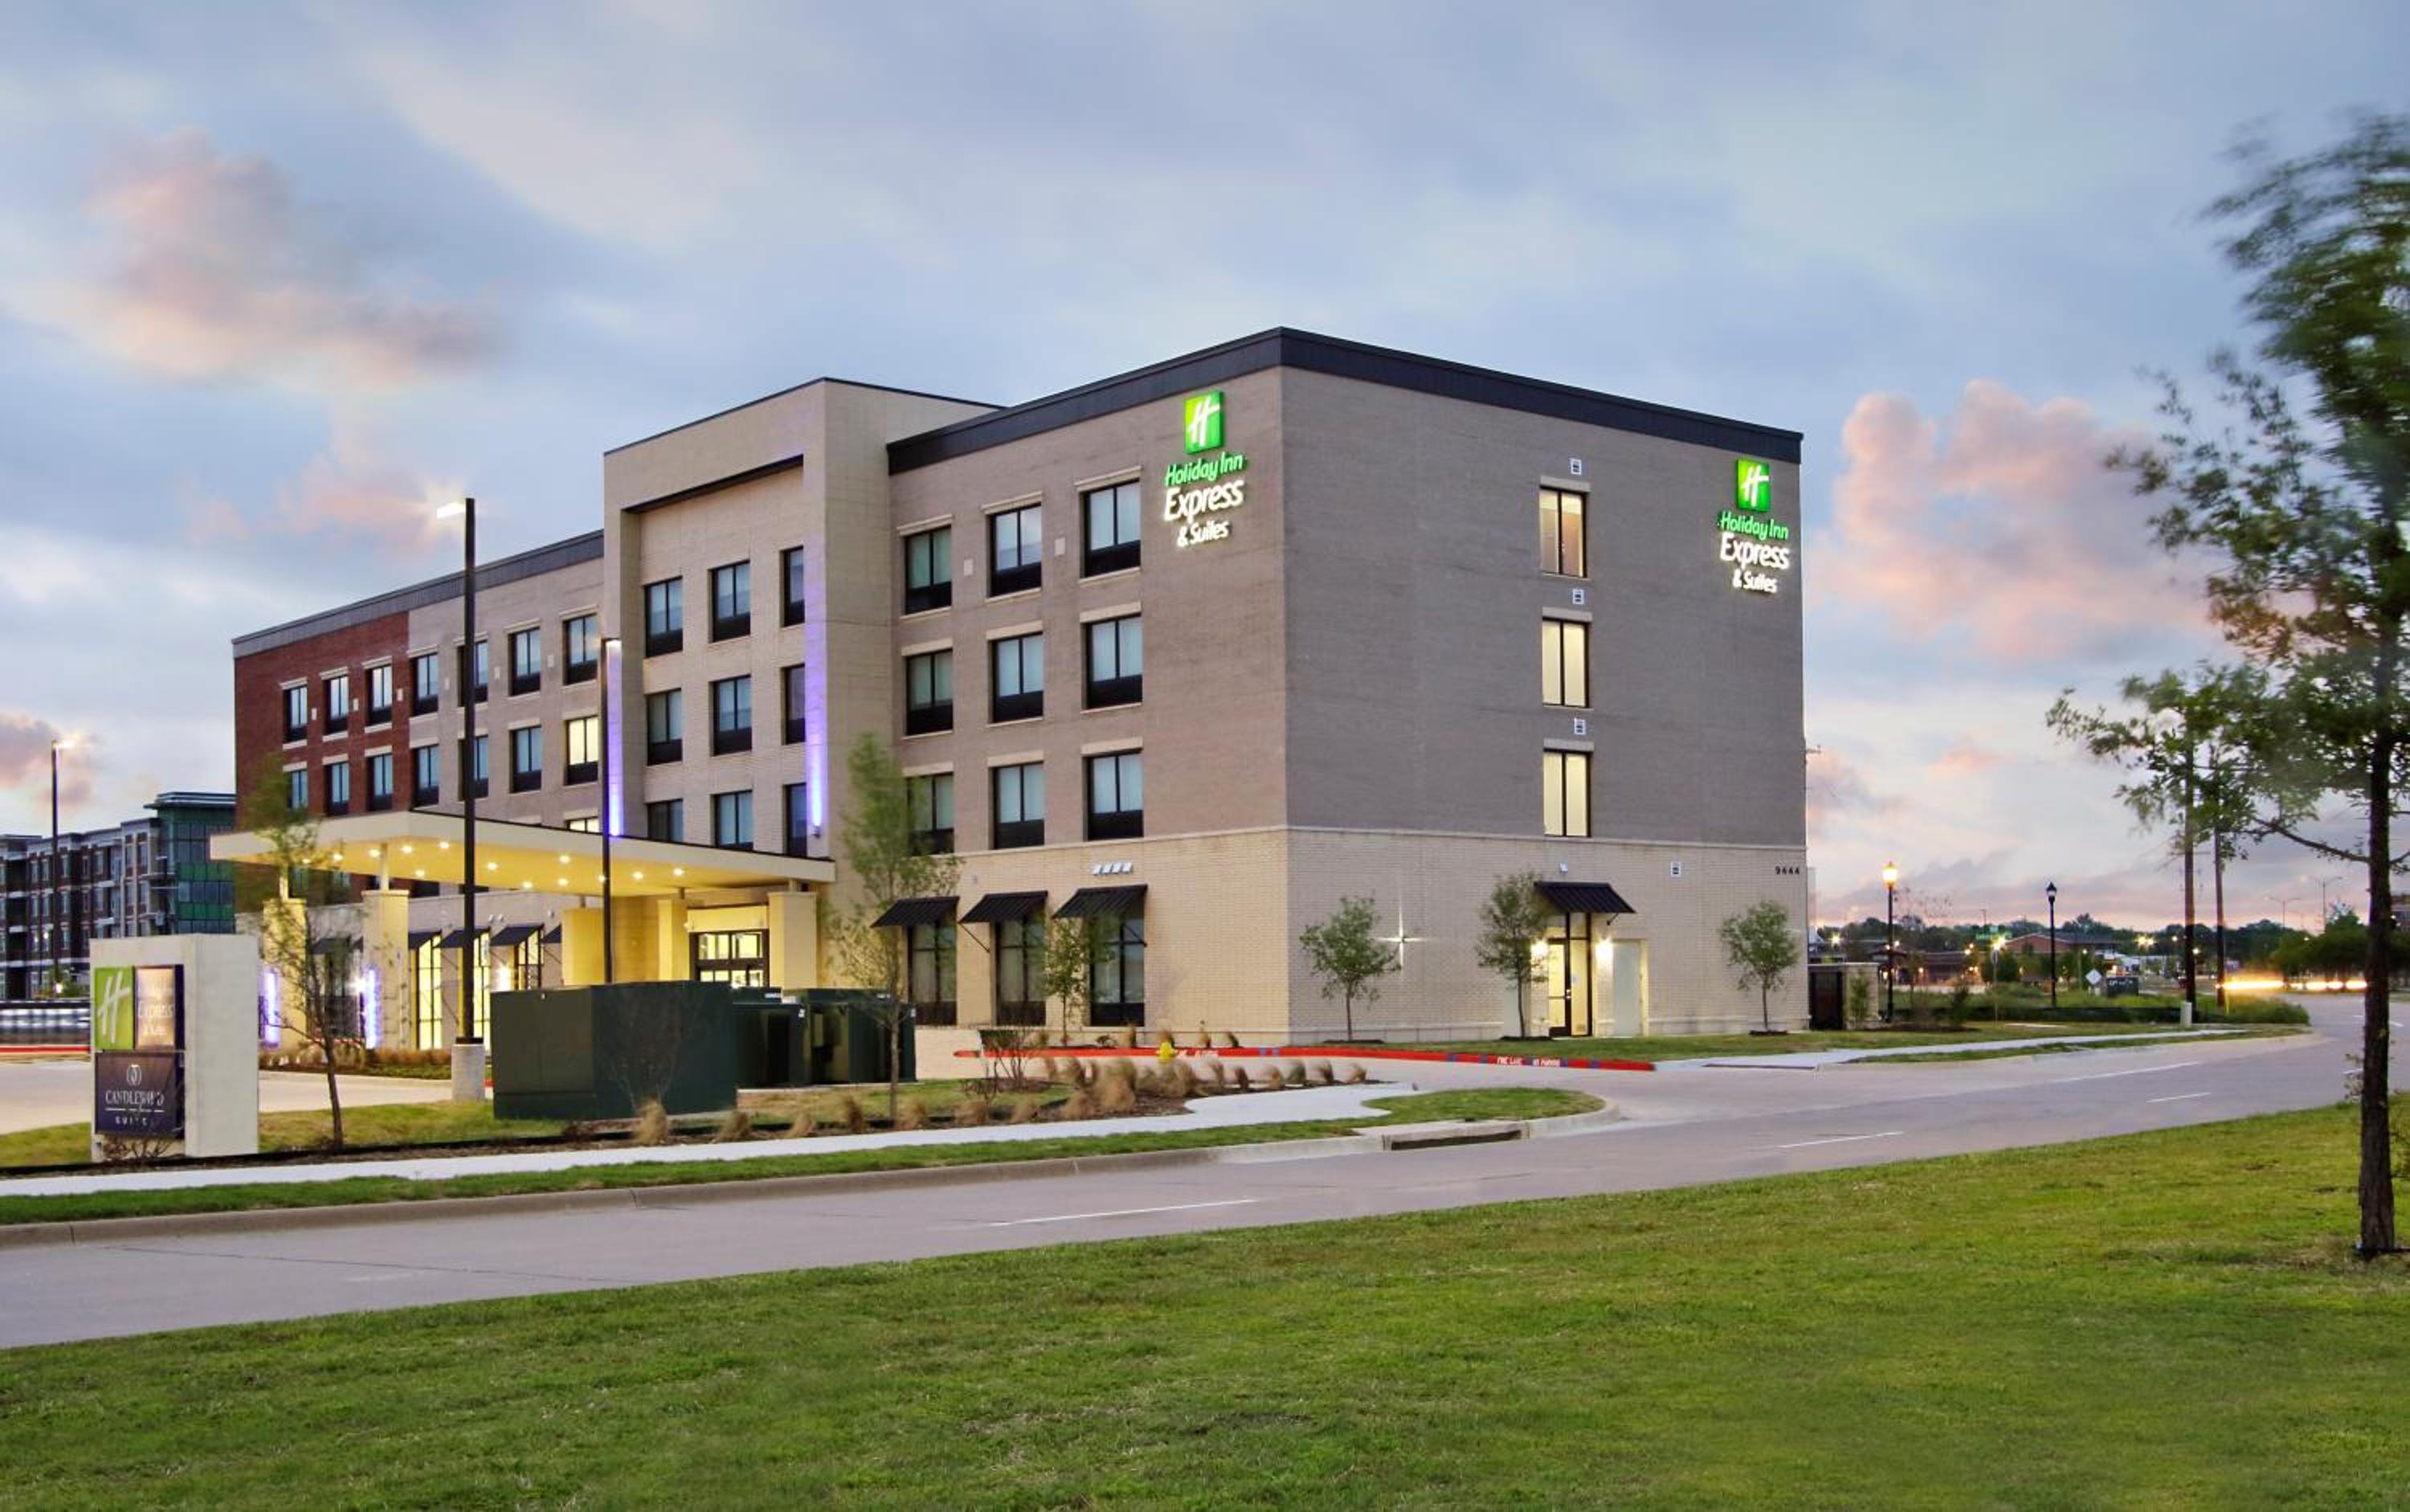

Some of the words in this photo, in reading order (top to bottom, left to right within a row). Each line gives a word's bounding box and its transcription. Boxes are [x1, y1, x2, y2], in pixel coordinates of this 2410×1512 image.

[1165, 458, 1218, 486] Holiday
[1220, 452, 1243, 474] Inn
[1164, 480, 1244, 524] Express
[1177, 525, 1188, 547] &
[1190, 520, 1229, 544] Suites
[1721, 510, 1767, 540] Holiday
[1769, 518, 1788, 540] Inn
[1720, 531, 1790, 570] Express
[1733, 568, 1742, 588] &
[1743, 571, 1777, 593] Suites
